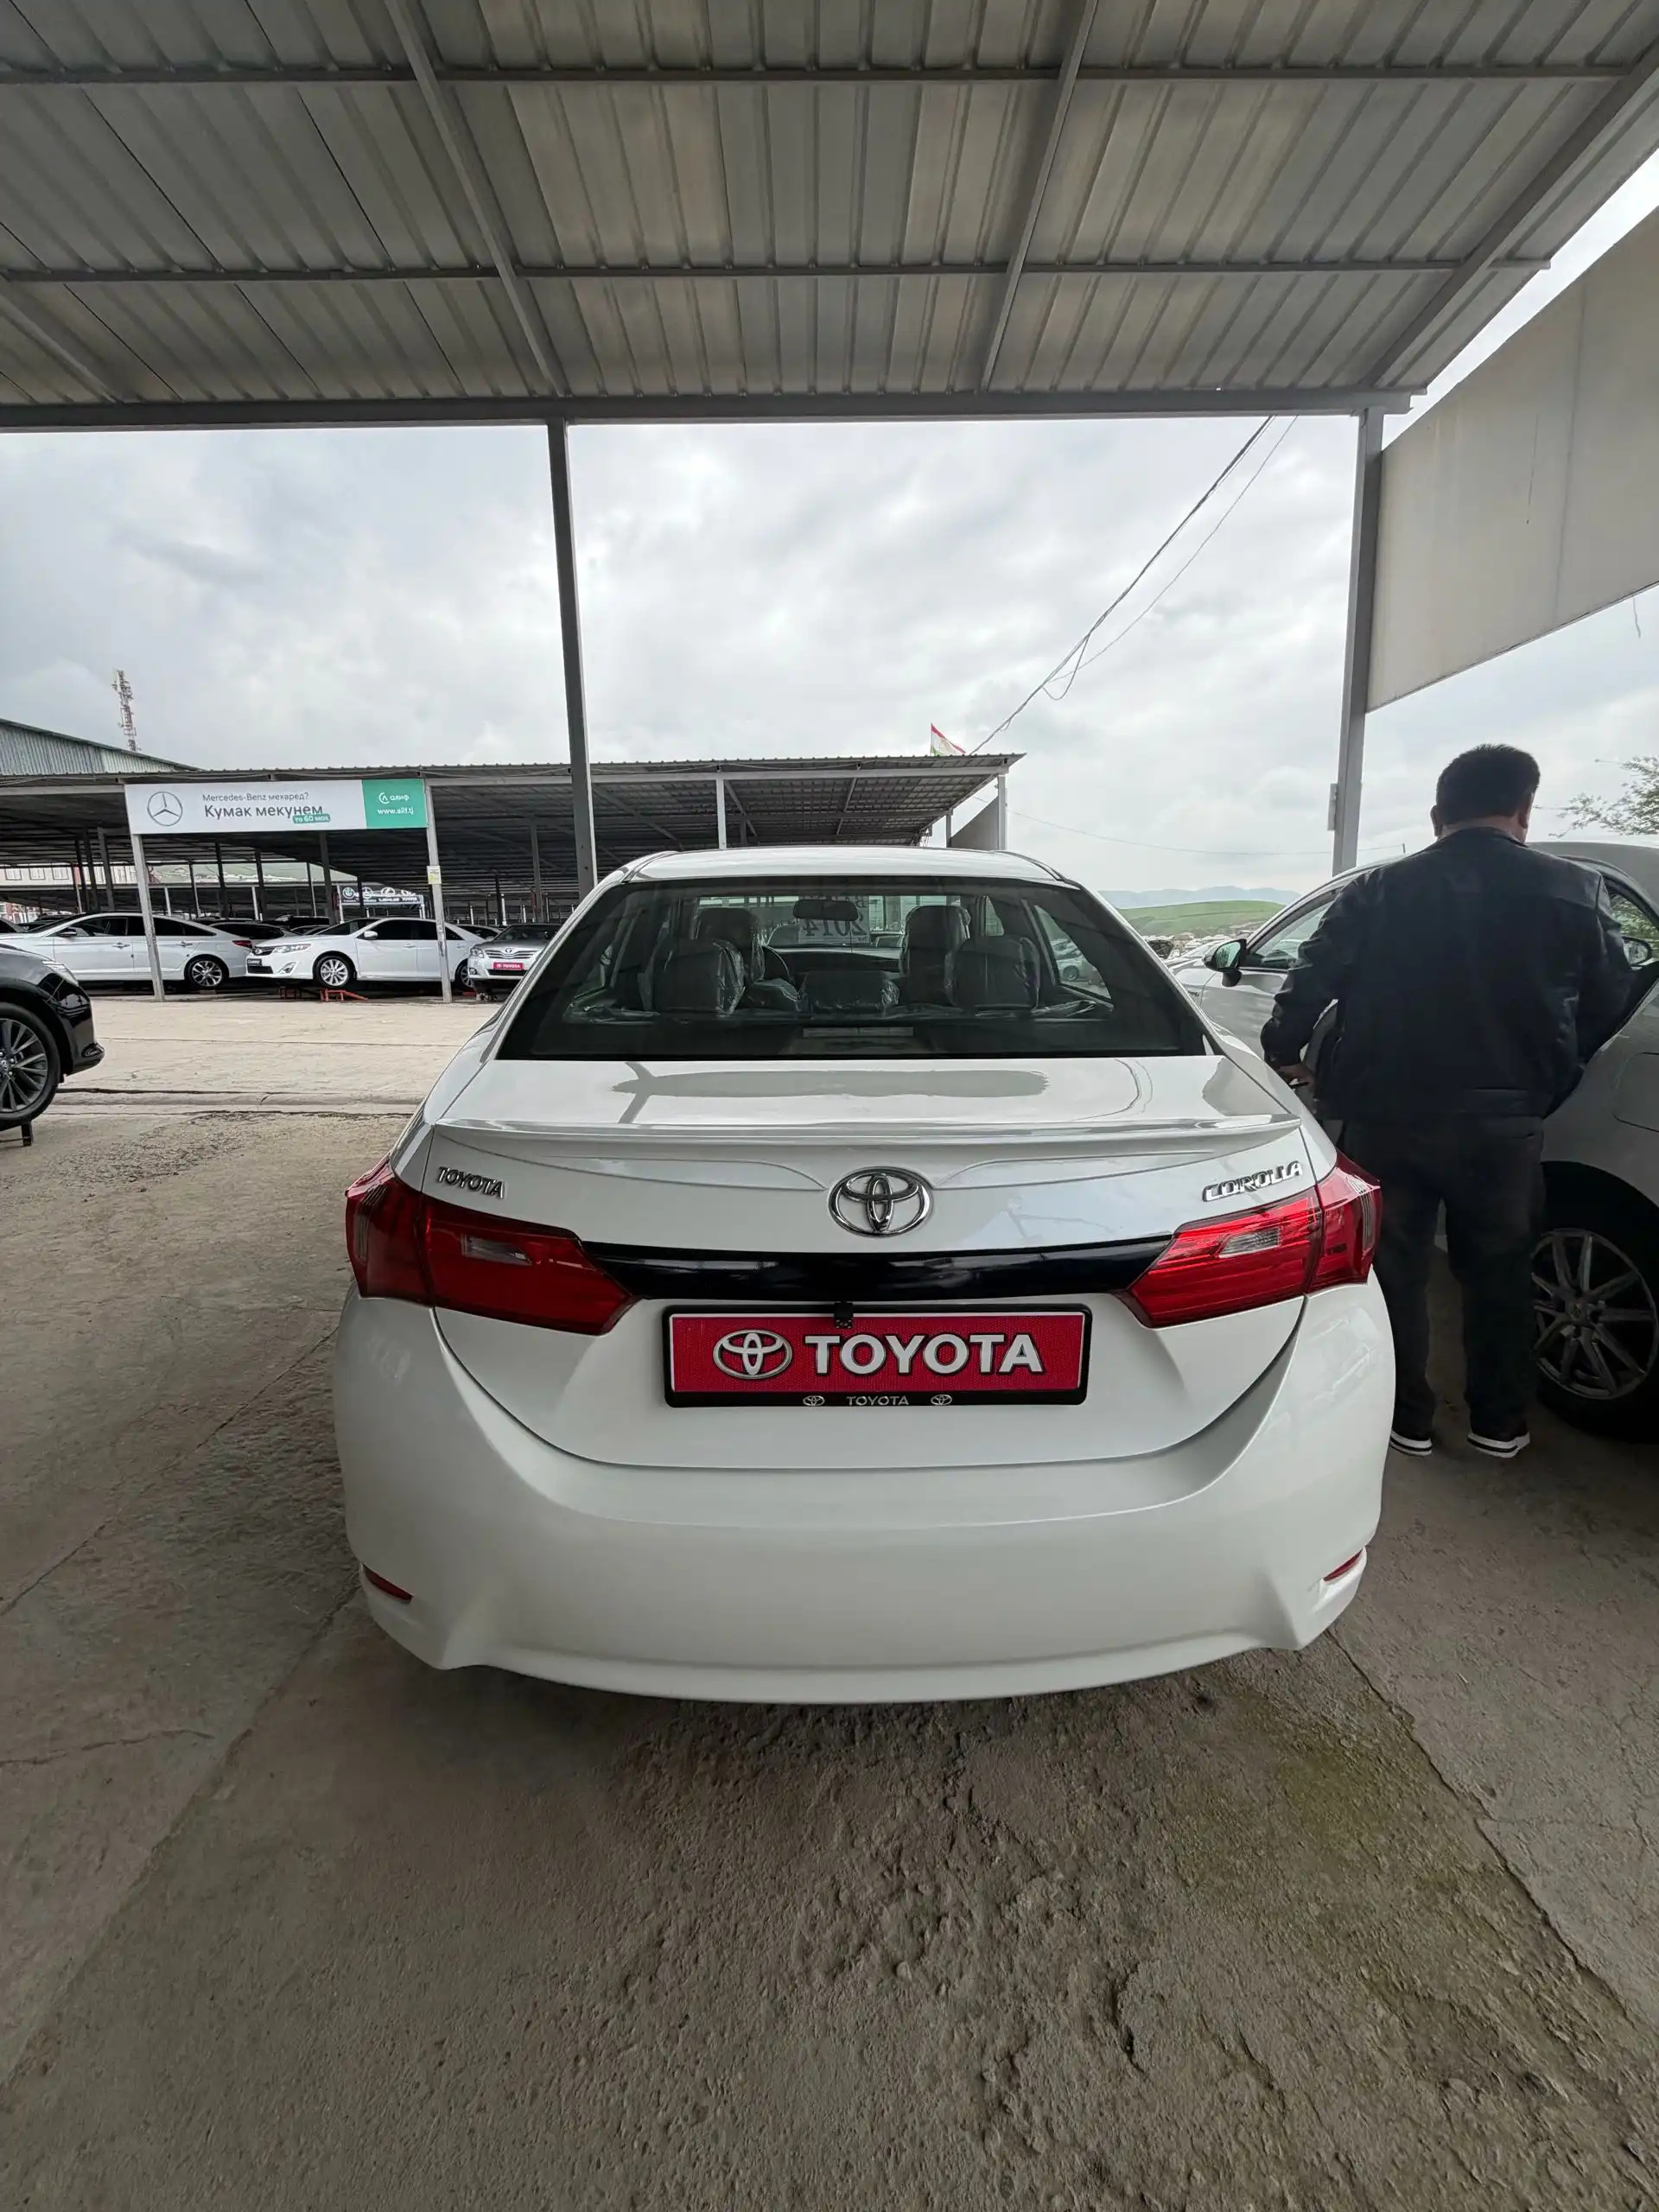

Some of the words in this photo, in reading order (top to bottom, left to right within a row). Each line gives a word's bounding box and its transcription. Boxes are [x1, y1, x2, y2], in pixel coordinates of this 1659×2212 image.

[202, 792, 267, 802] Mercedes-Benz
[205, 804, 252, 820] Кумак
[256, 804, 323, 820] мекунем
[436, 1166, 505, 1199] TOYOTA
[1202, 1160, 1304, 1203] COROLLA
[804, 1333, 1045, 1376] TOYOTA
[846, 1395, 909, 1407] TOYOTA
